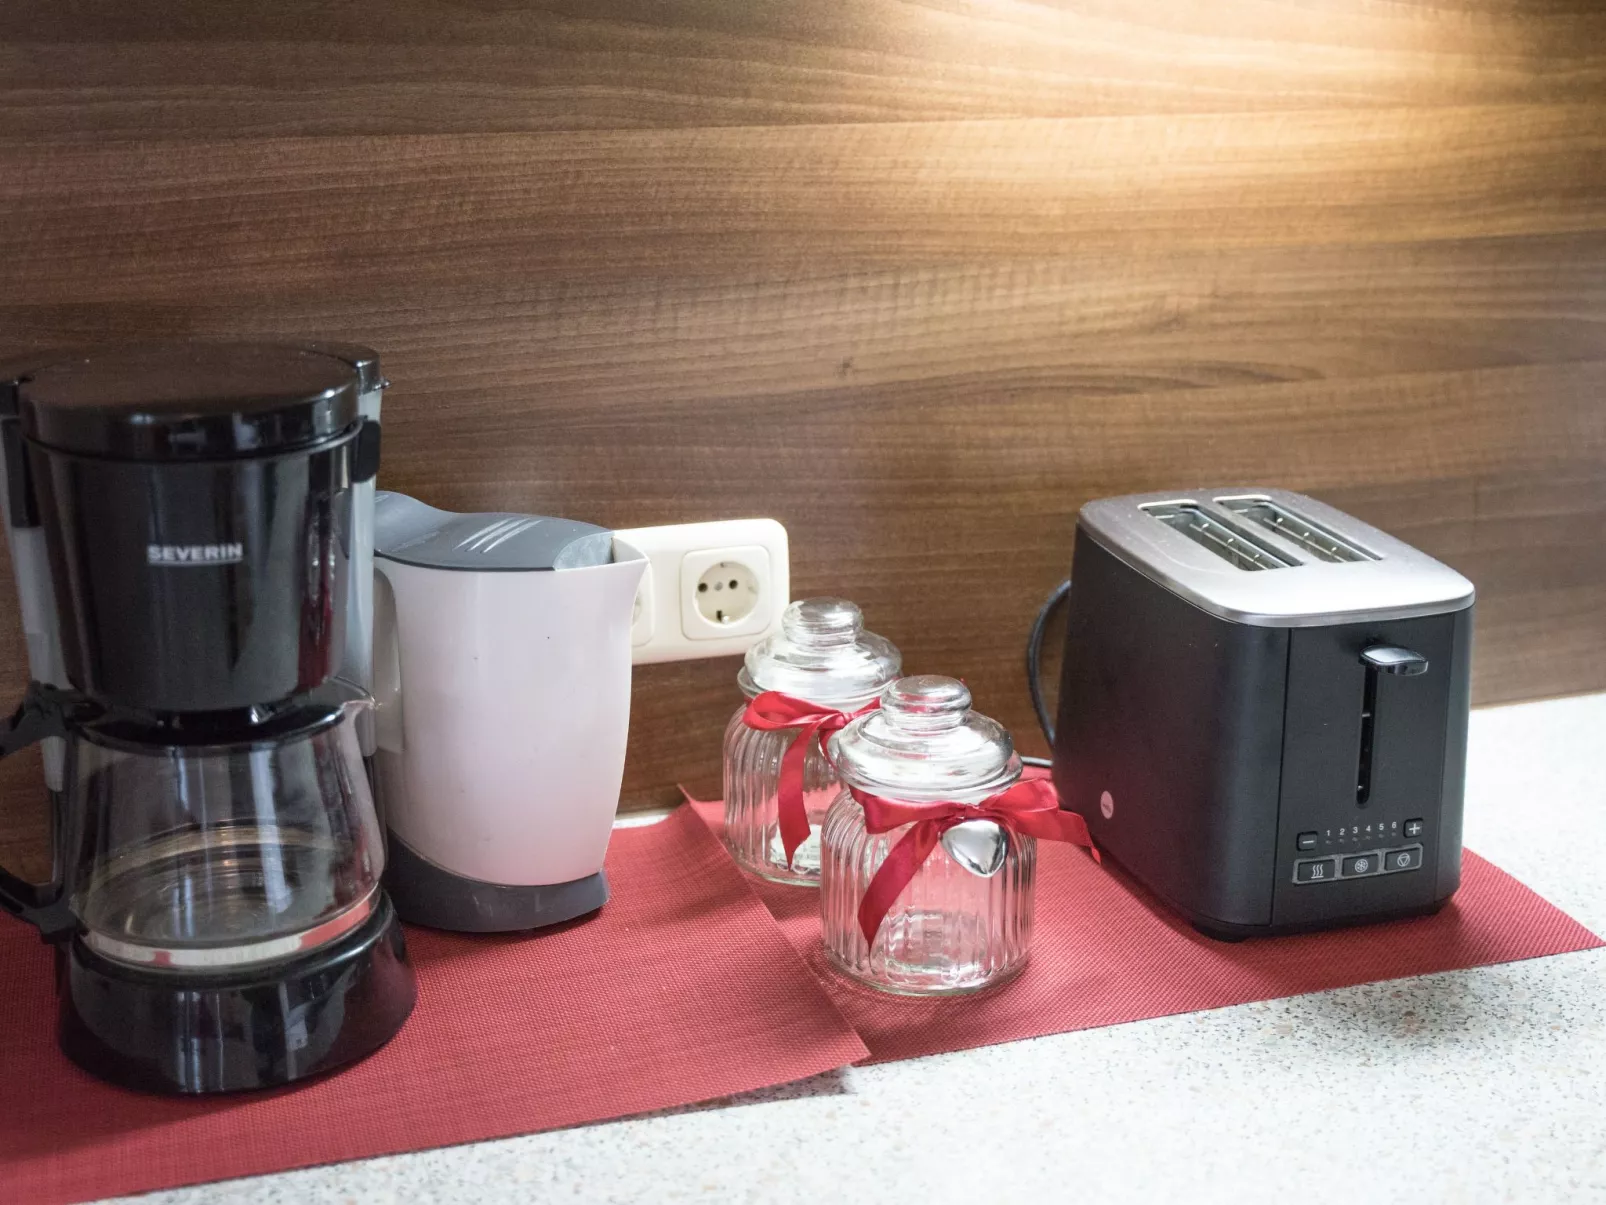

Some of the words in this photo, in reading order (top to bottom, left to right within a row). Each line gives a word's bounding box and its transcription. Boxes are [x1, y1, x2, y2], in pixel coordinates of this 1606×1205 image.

[147, 542, 243, 563] SEVERIN
[1352, 826, 1358, 834] 3
[1378, 823, 1384, 831] 5
[1391, 821, 1397, 829] 6
